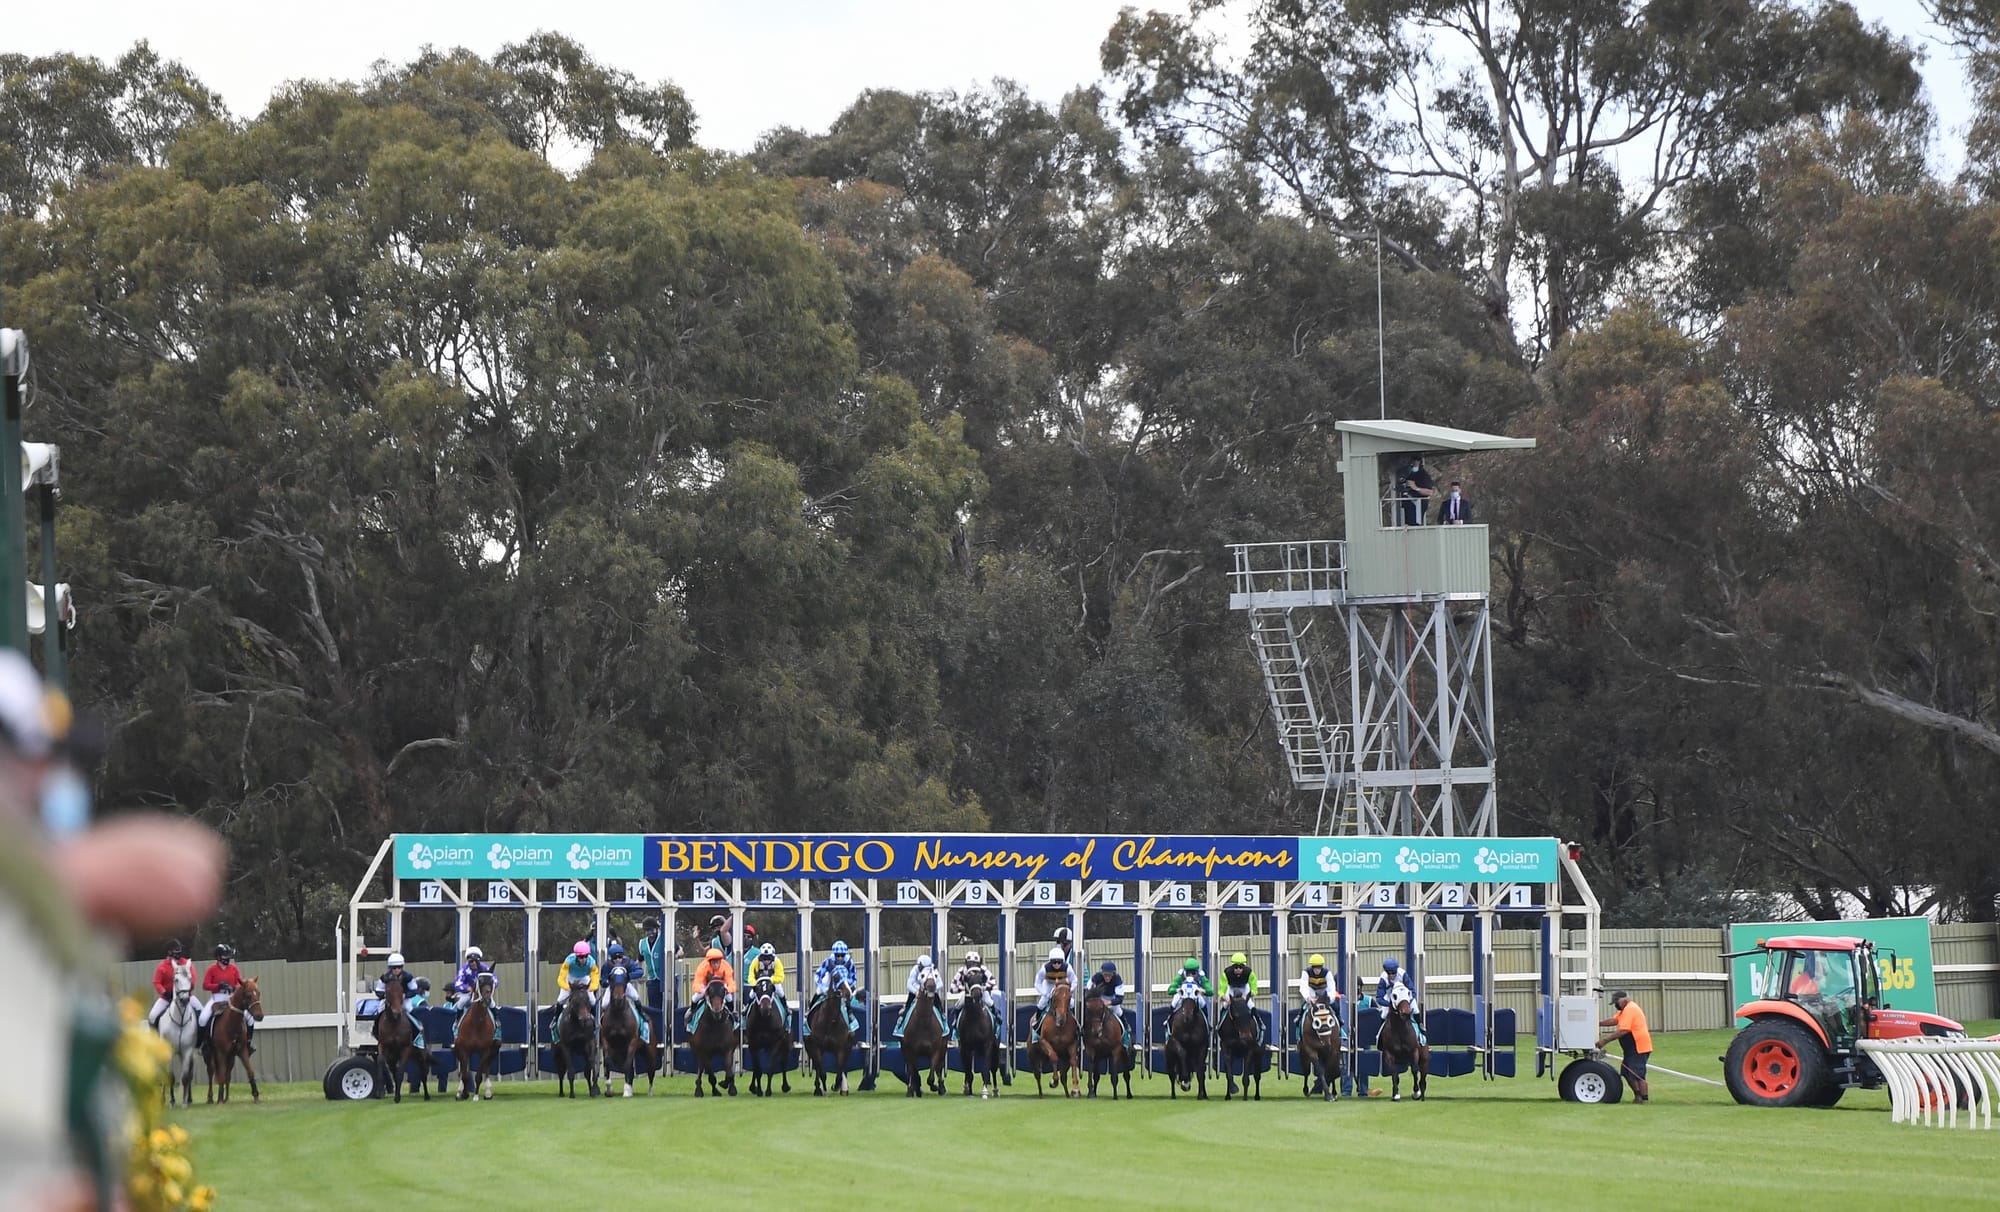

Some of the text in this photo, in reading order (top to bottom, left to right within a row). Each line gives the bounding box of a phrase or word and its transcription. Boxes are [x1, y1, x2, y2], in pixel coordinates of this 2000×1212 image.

[420, 845, 474, 861] Apiam
[499, 845, 553, 861] Apiam
[578, 845, 632, 861] Apiam
[657, 837, 1293, 880] BENDIGO Nursery of Champions
[1328, 849, 1382, 865] Apiam
[1407, 849, 1461, 865] Apiam
[1486, 849, 1540, 865] Apiam
[421, 886, 441, 899] 17
[489, 885, 509, 899] 16
[558, 886, 578, 899] 15
[627, 886, 646, 899] 14
[695, 886, 714, 899] 13
[763, 886, 782, 899] 12
[833, 886, 850, 900] 11
[899, 886, 918, 899] 10
[971, 886, 982, 900] 9
[1039, 886, 1050, 900] 8
[1108, 887, 1118, 901] 7
[1175, 887, 1186, 902] 6
[1244, 888, 1254, 902] 5
[1311, 889, 1322, 903] 4
[1380, 889, 1390, 903] 3
[1447, 889, 1458, 904] 2
